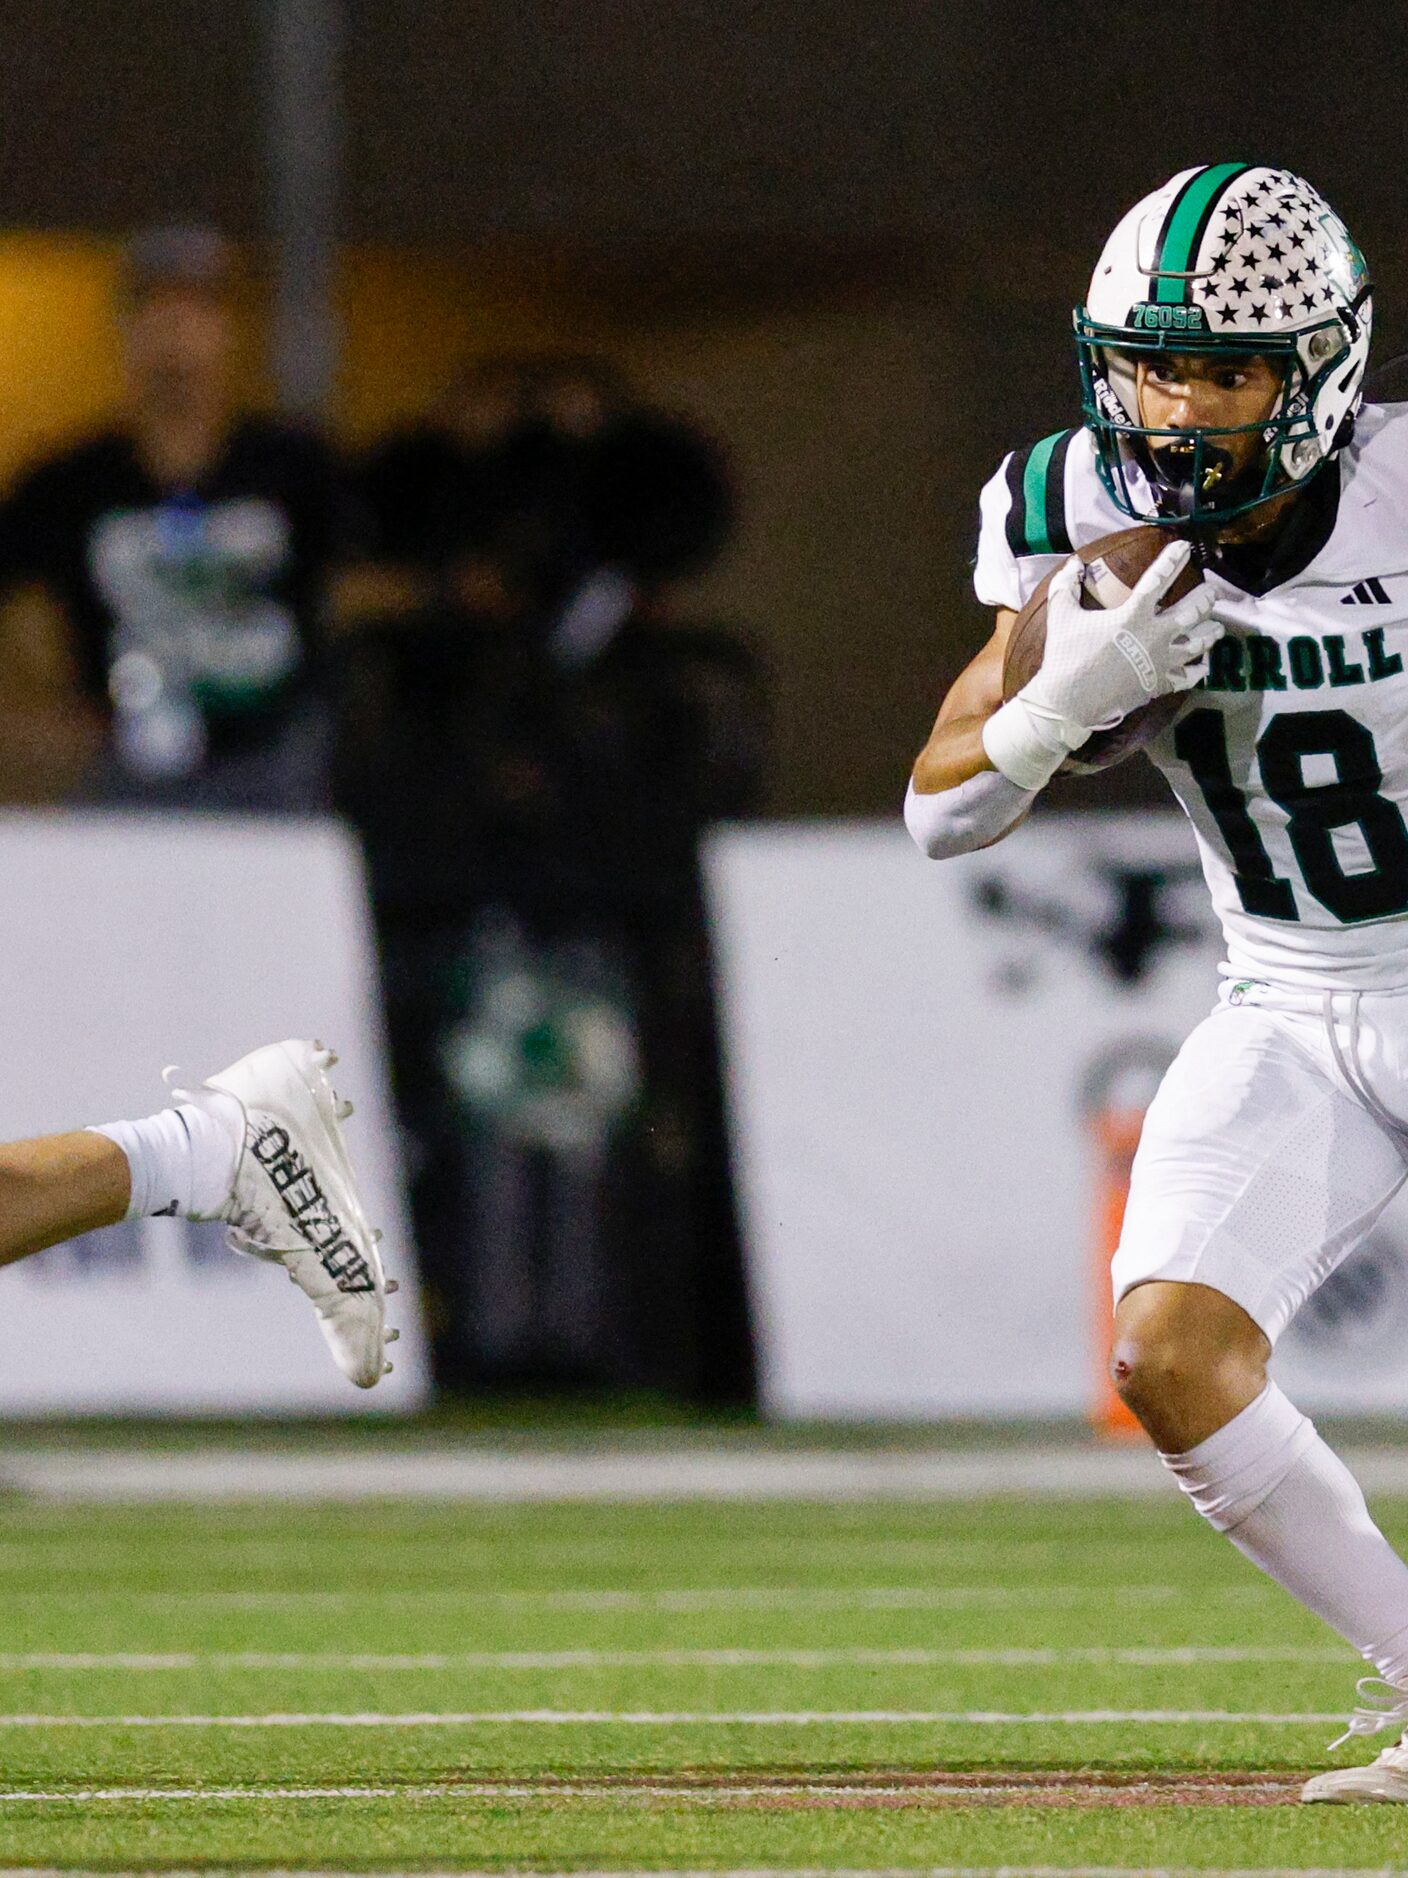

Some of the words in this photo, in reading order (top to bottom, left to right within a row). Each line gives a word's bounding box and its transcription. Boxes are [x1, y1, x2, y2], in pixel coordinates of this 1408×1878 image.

[1132, 304, 1202, 329] 76092
[1198, 628, 1404, 692] RROLL
[251, 1126, 376, 1293] ADIZERO
